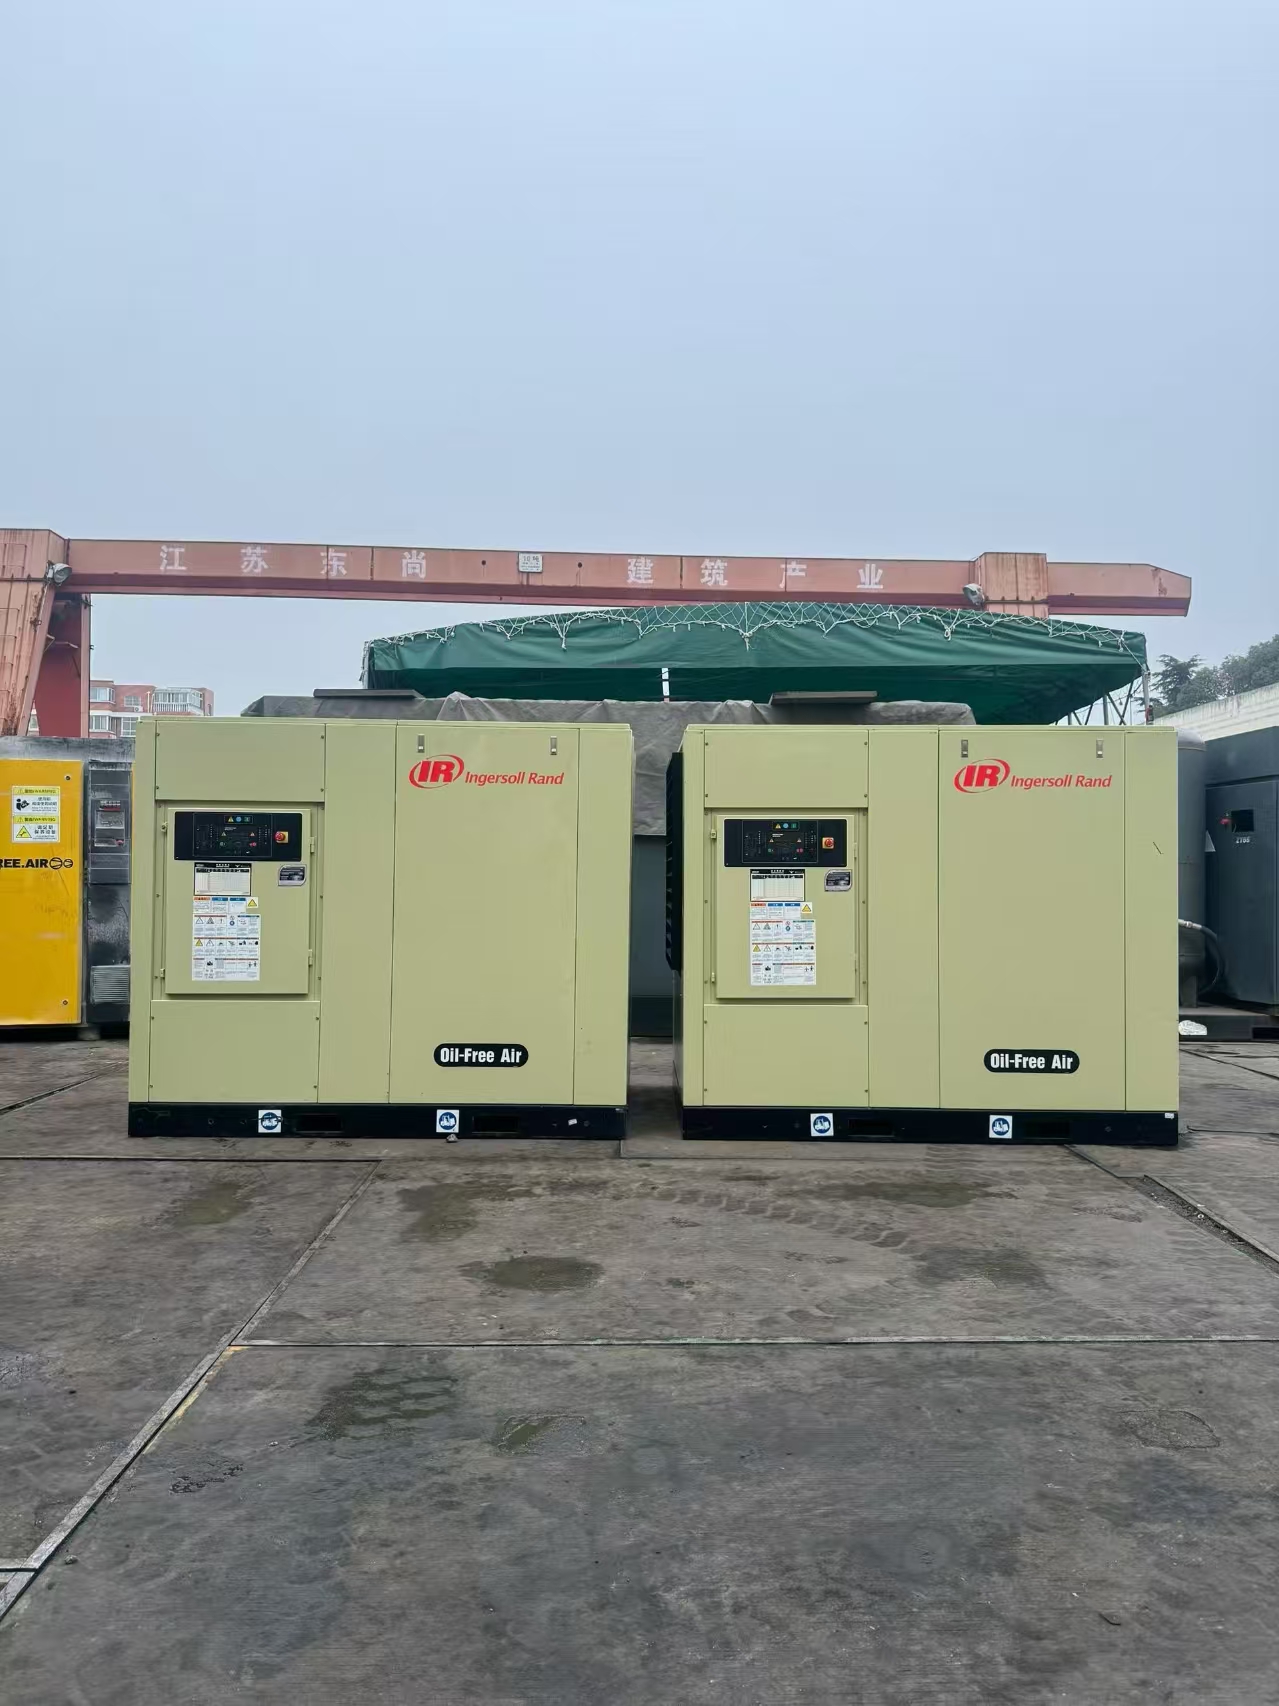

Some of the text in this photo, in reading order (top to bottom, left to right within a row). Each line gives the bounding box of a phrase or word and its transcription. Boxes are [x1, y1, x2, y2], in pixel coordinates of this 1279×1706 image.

[418, 760, 565, 787] IR Ingersoll Rand
[963, 765, 1113, 790] IR Ingersoll Rand
[440, 1047, 522, 1063] Oil-Free Air
[990, 1053, 1073, 1069] Oil-Free Air
